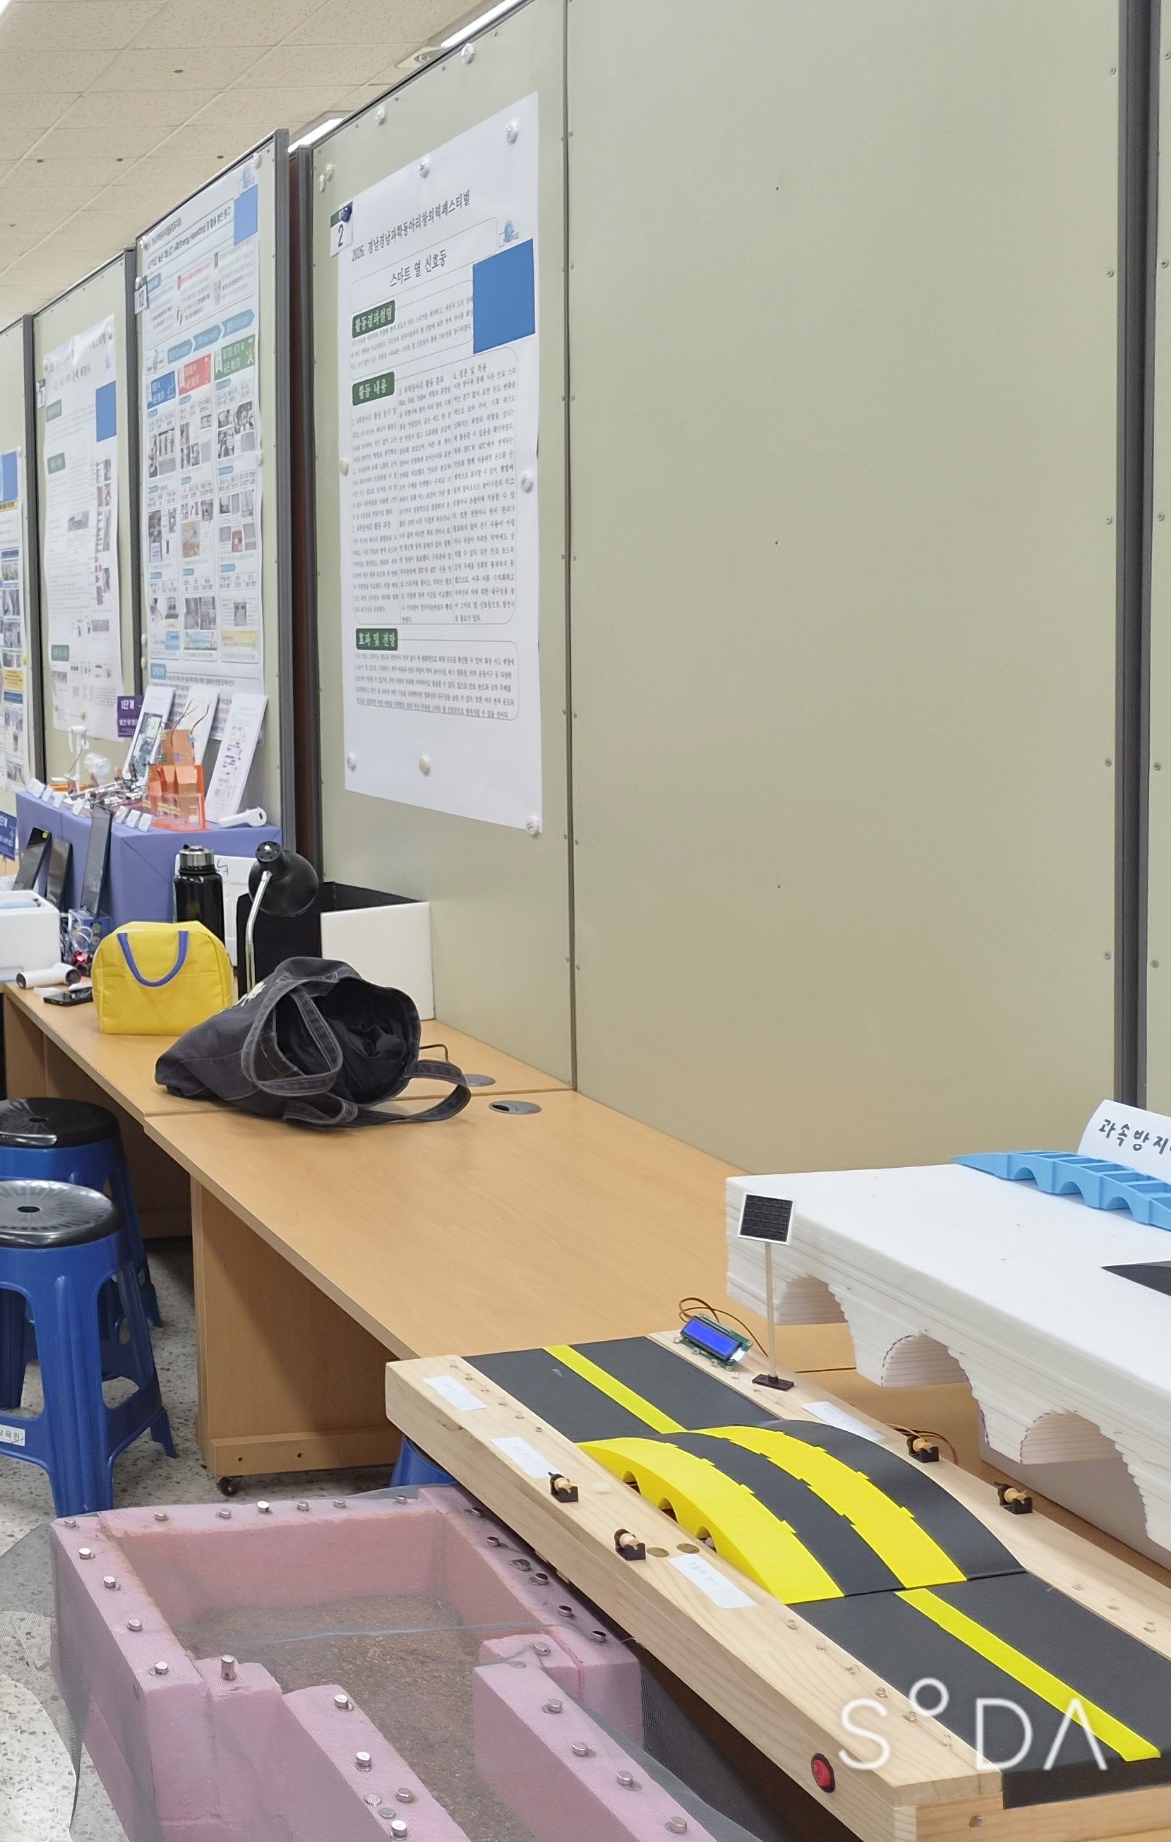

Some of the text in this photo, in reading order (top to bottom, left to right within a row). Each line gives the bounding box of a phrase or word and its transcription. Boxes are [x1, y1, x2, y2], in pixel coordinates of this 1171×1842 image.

[338, 224, 344, 247] 2
[390, 249, 447, 287] 스마트 열 신호등
[359, 379, 387, 400] 활동 내용
[1098, 1118, 1171, 1156] 과속방지
